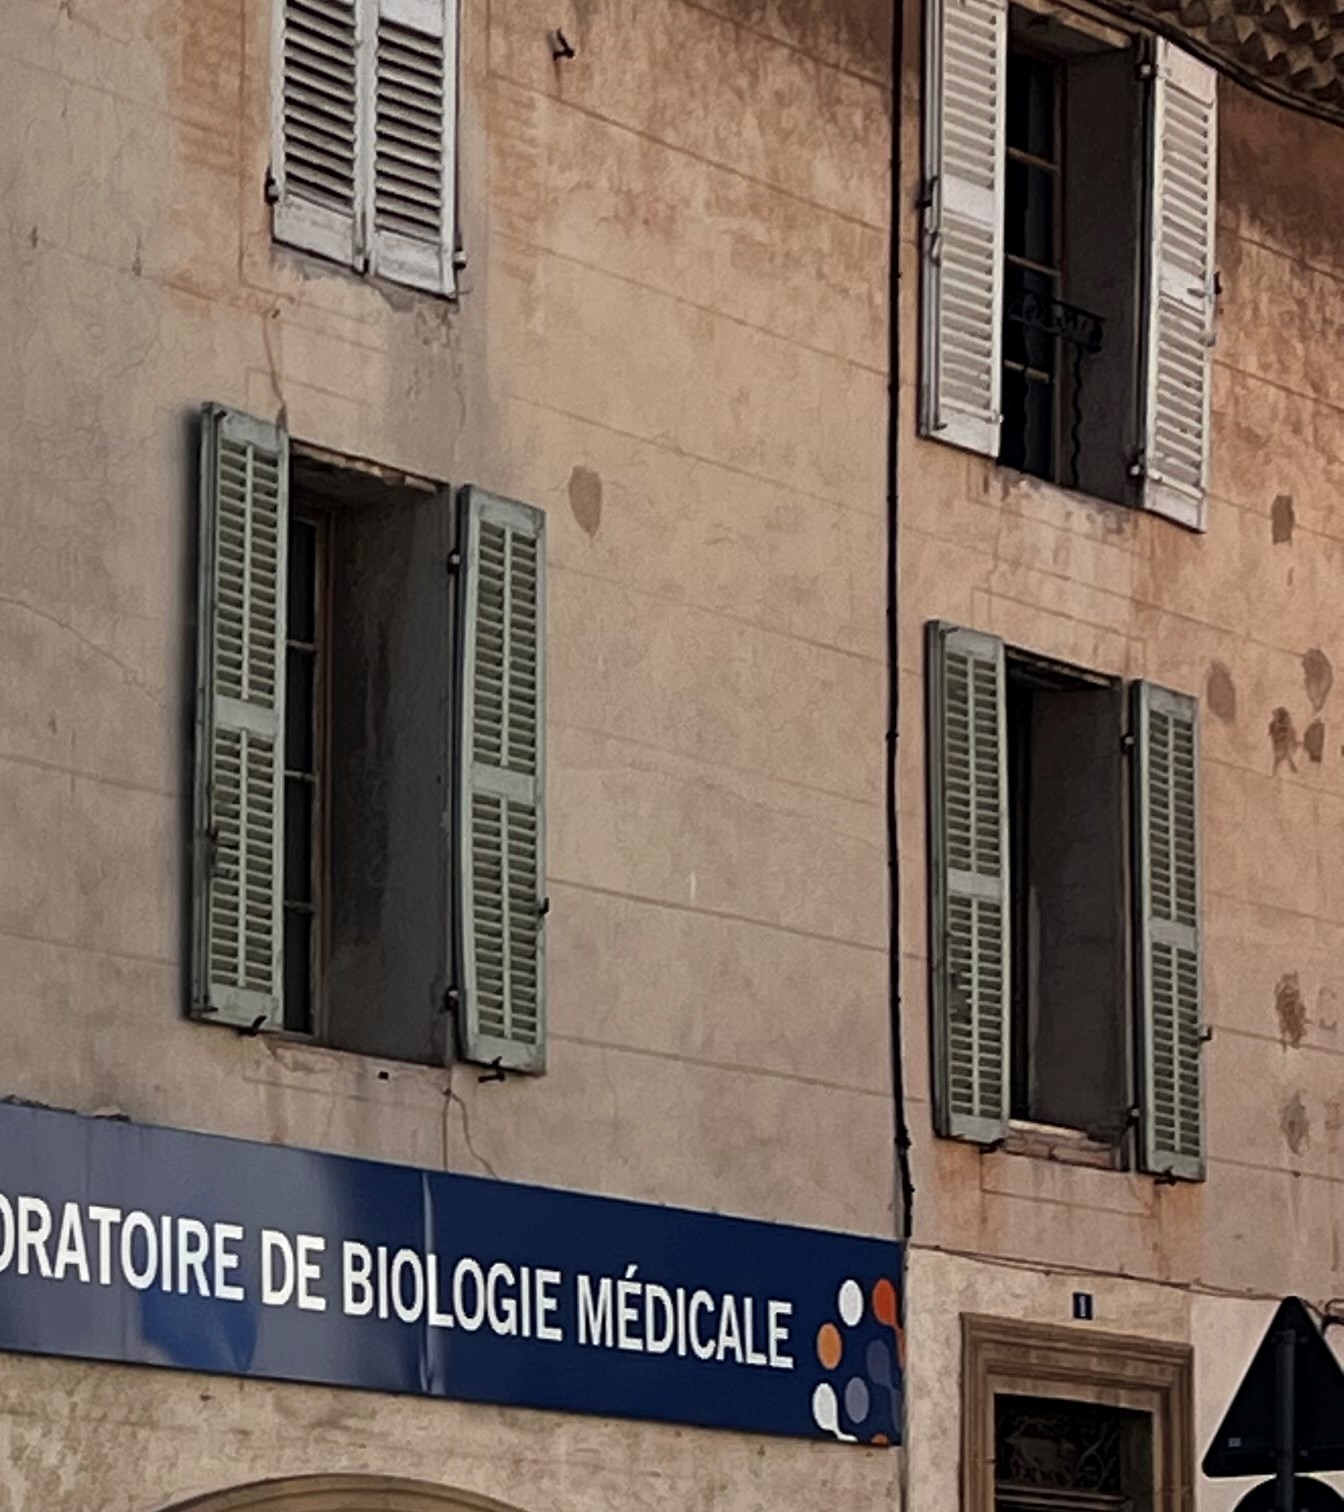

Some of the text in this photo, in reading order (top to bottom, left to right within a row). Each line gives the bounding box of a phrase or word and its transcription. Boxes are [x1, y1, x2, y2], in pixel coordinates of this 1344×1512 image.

[260, 1228, 326, 1312] DE
[342, 1239, 562, 1342] BIOLOGIE
[577, 1265, 794, 1369] MÉDICALE
